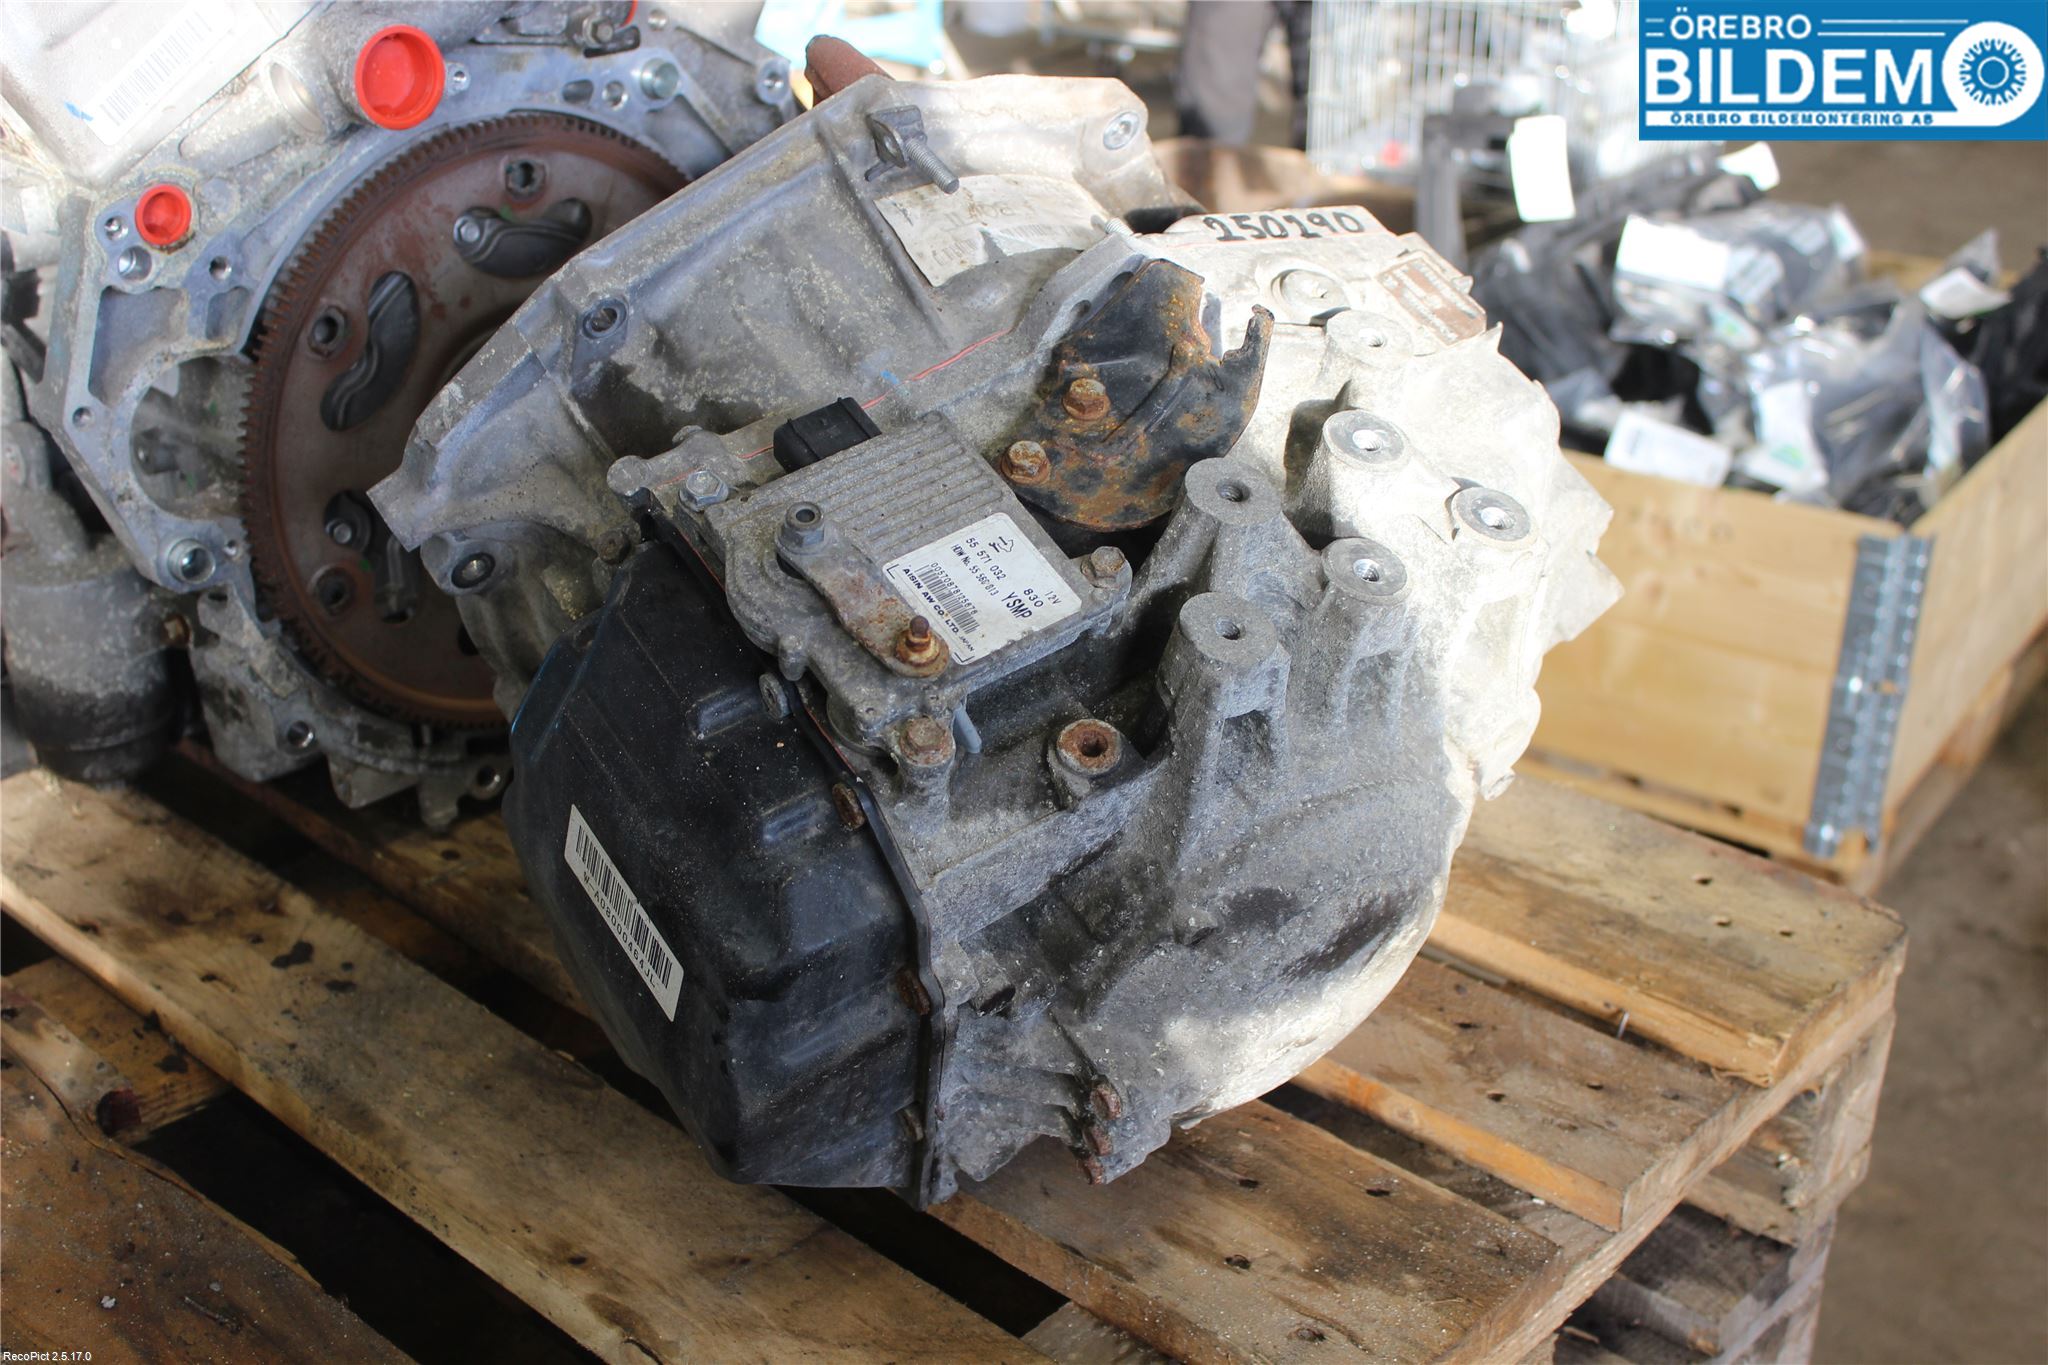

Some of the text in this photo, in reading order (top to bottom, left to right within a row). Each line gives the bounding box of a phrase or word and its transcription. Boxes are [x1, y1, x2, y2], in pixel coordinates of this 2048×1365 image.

[966, 536, 1007, 581] 55 571 032
[968, 564, 979, 574] 55
[984, 582, 999, 596] 813
[902, 567, 924, 590] AISIN
[921, 591, 936, 604] AW
[958, 635, 975, 652] JAPAN
[1000, 591, 1033, 620] YSMP
[1023, 588, 1044, 608] 830
[1044, 590, 1062, 605] 12V
